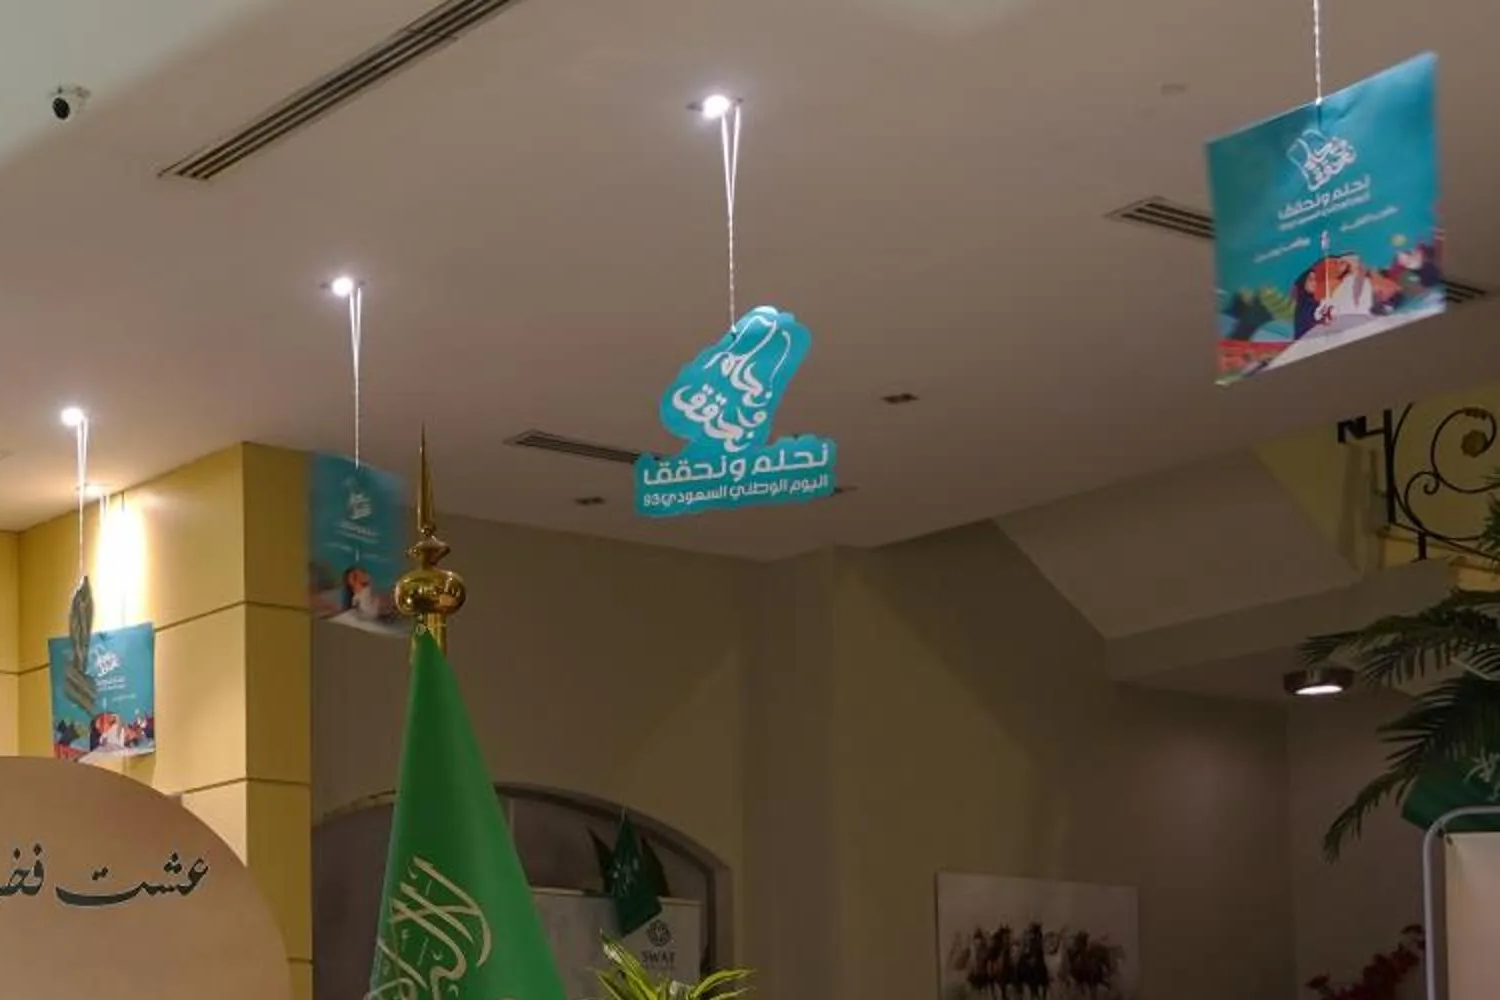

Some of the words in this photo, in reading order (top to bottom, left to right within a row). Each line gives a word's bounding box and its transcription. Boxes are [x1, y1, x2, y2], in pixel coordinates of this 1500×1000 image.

[643, 455, 746, 486] ونحقق
[751, 443, 829, 475] نحلم
[662, 485, 728, 506] السعودي
[729, 479, 788, 500] الوطني
[789, 474, 828, 494] اليوم
[55, 851, 209, 907] عشت
